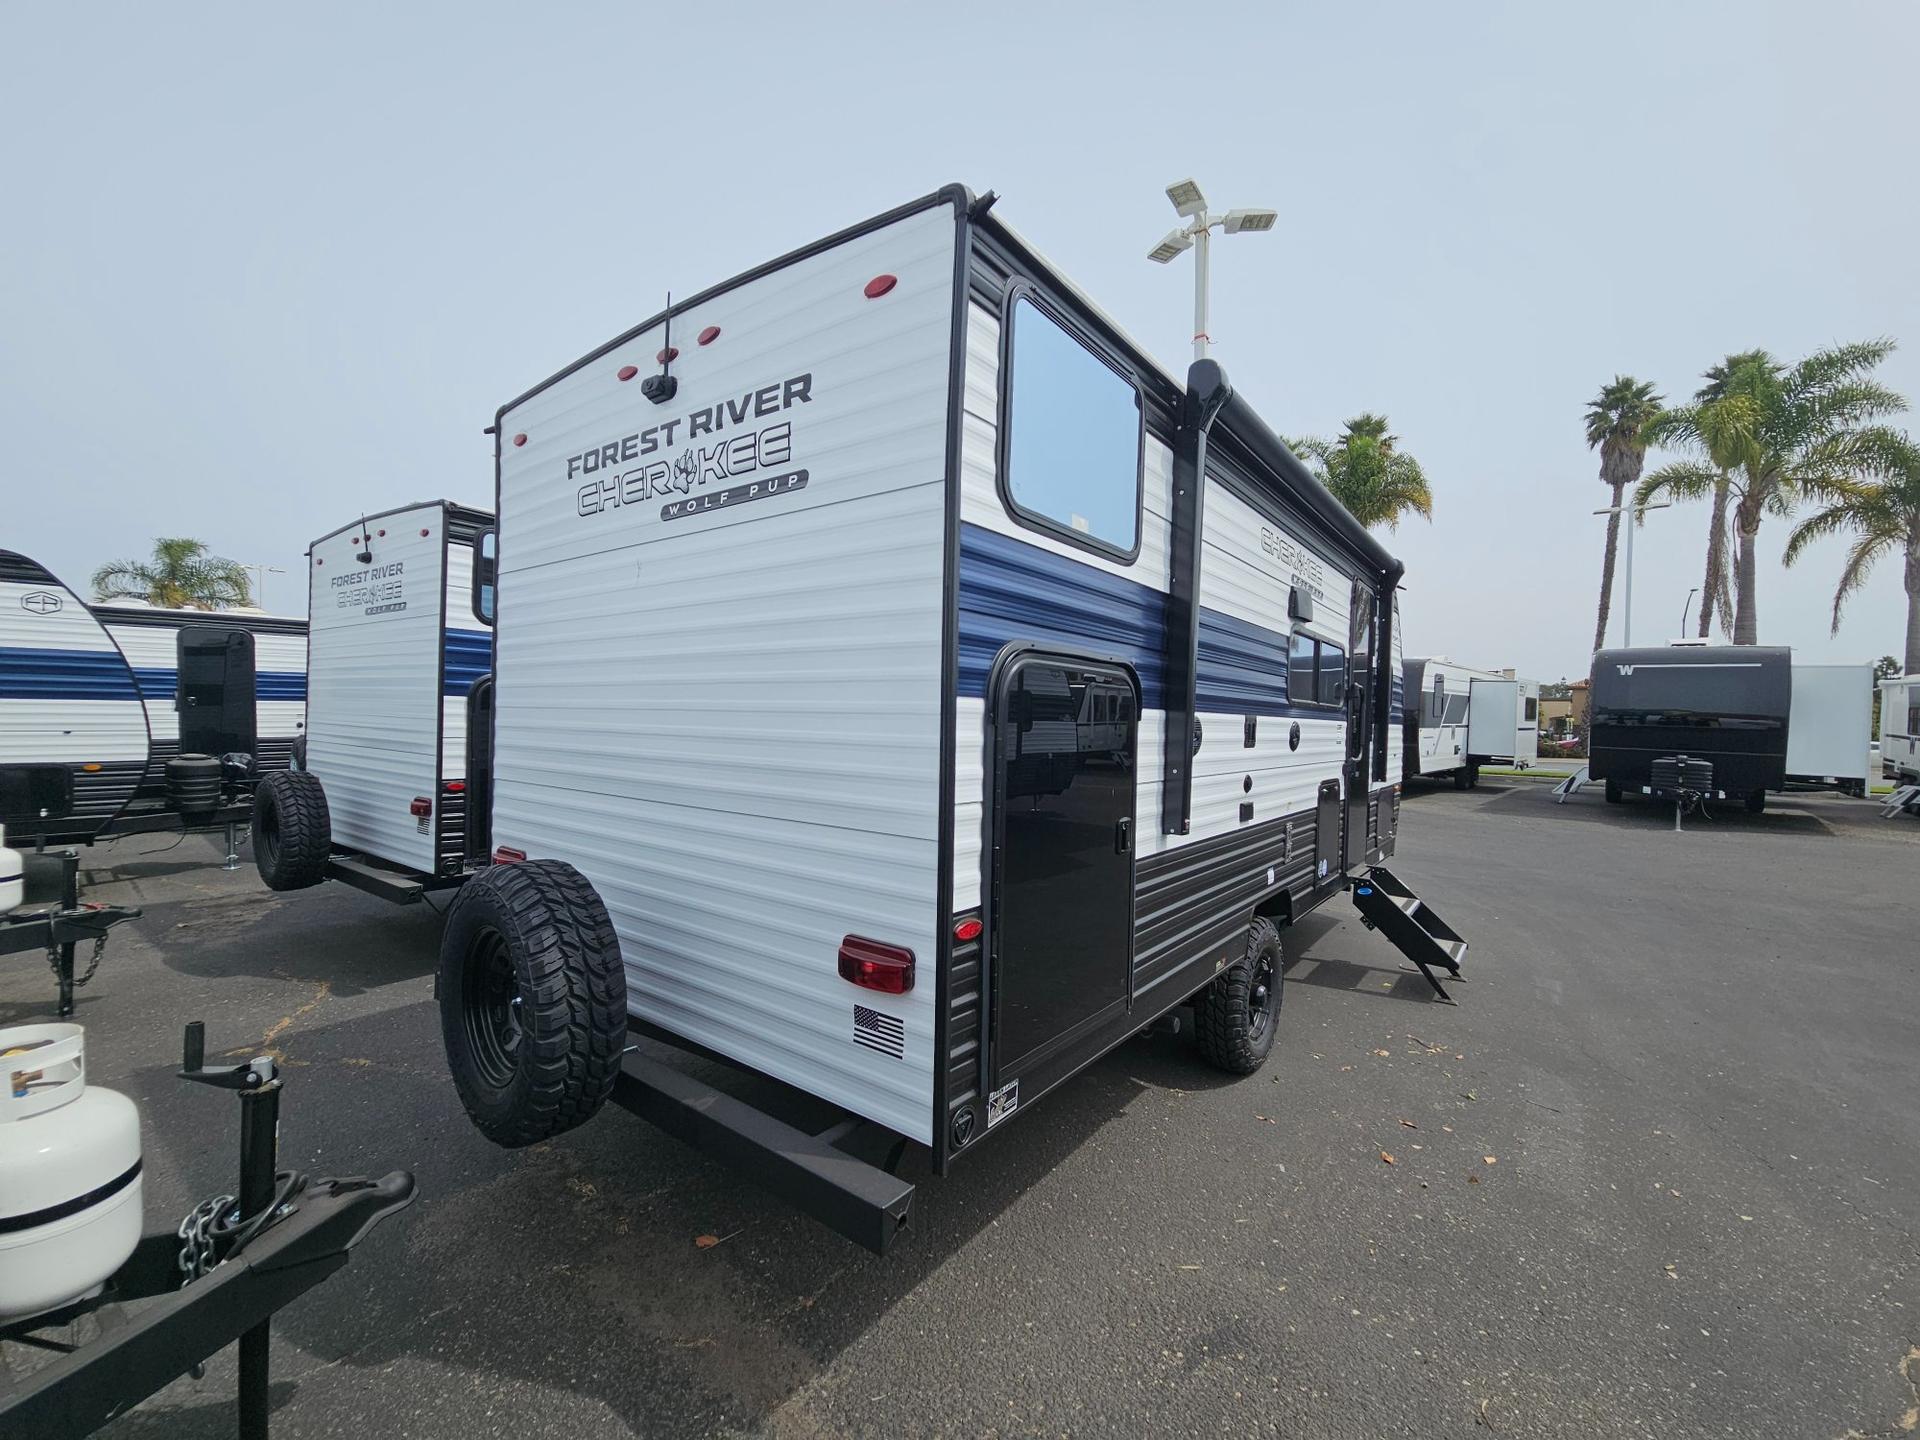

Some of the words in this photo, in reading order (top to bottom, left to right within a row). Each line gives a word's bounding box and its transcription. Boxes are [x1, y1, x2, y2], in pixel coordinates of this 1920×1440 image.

[567, 419, 682, 480] FOREST
[689, 373, 813, 439] RIVER
[669, 492, 730, 516] WOLF
[749, 474, 799, 498] PUP
[331, 570, 370, 589] FOREST
[371, 562, 404, 581] RIVER
